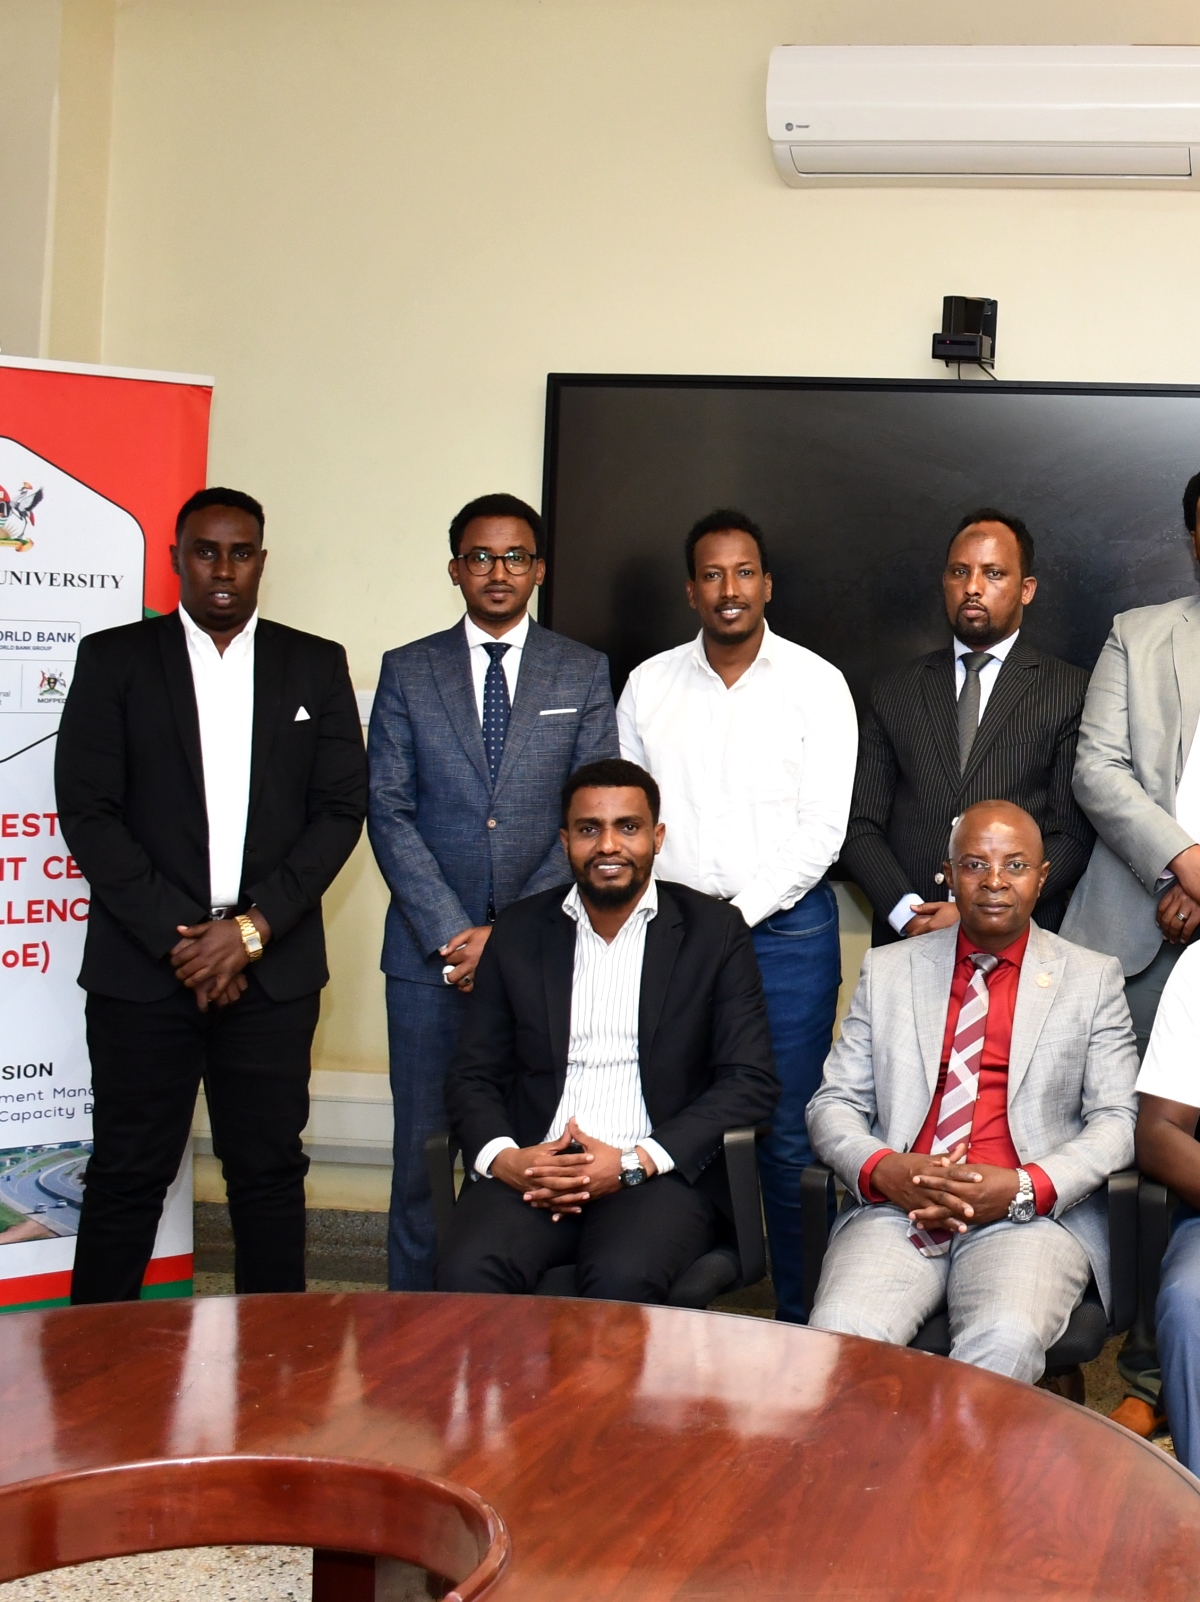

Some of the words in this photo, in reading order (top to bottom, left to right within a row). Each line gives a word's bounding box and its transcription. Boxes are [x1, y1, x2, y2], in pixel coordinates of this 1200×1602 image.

[37, 632, 76, 643] BANK
[2, 813, 58, 837] EST
[2, 940, 50, 974] oE)
[1, 1062, 53, 1080] SION
